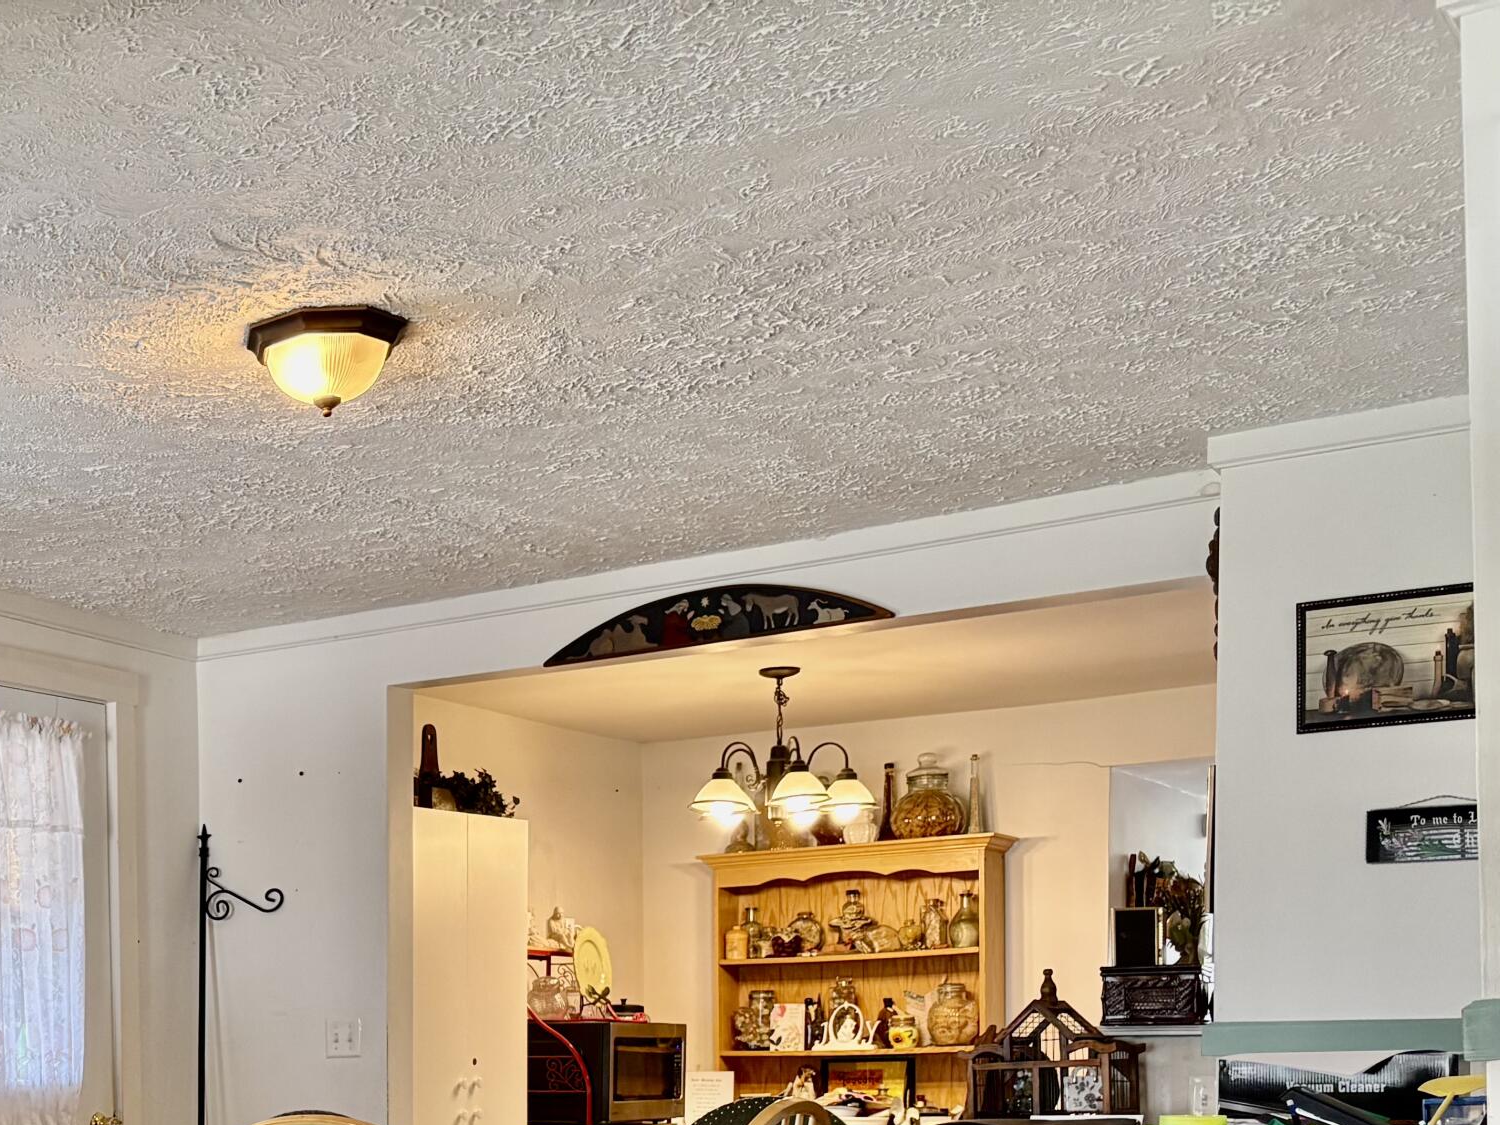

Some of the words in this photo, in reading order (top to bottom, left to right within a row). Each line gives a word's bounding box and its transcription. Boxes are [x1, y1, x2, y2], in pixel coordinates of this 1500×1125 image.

[1410, 814, 1426, 829] To
[1432, 816, 1448, 825] me
[1453, 812, 1463, 824] to
[1338, 1080, 1387, 1093] Cleaner
